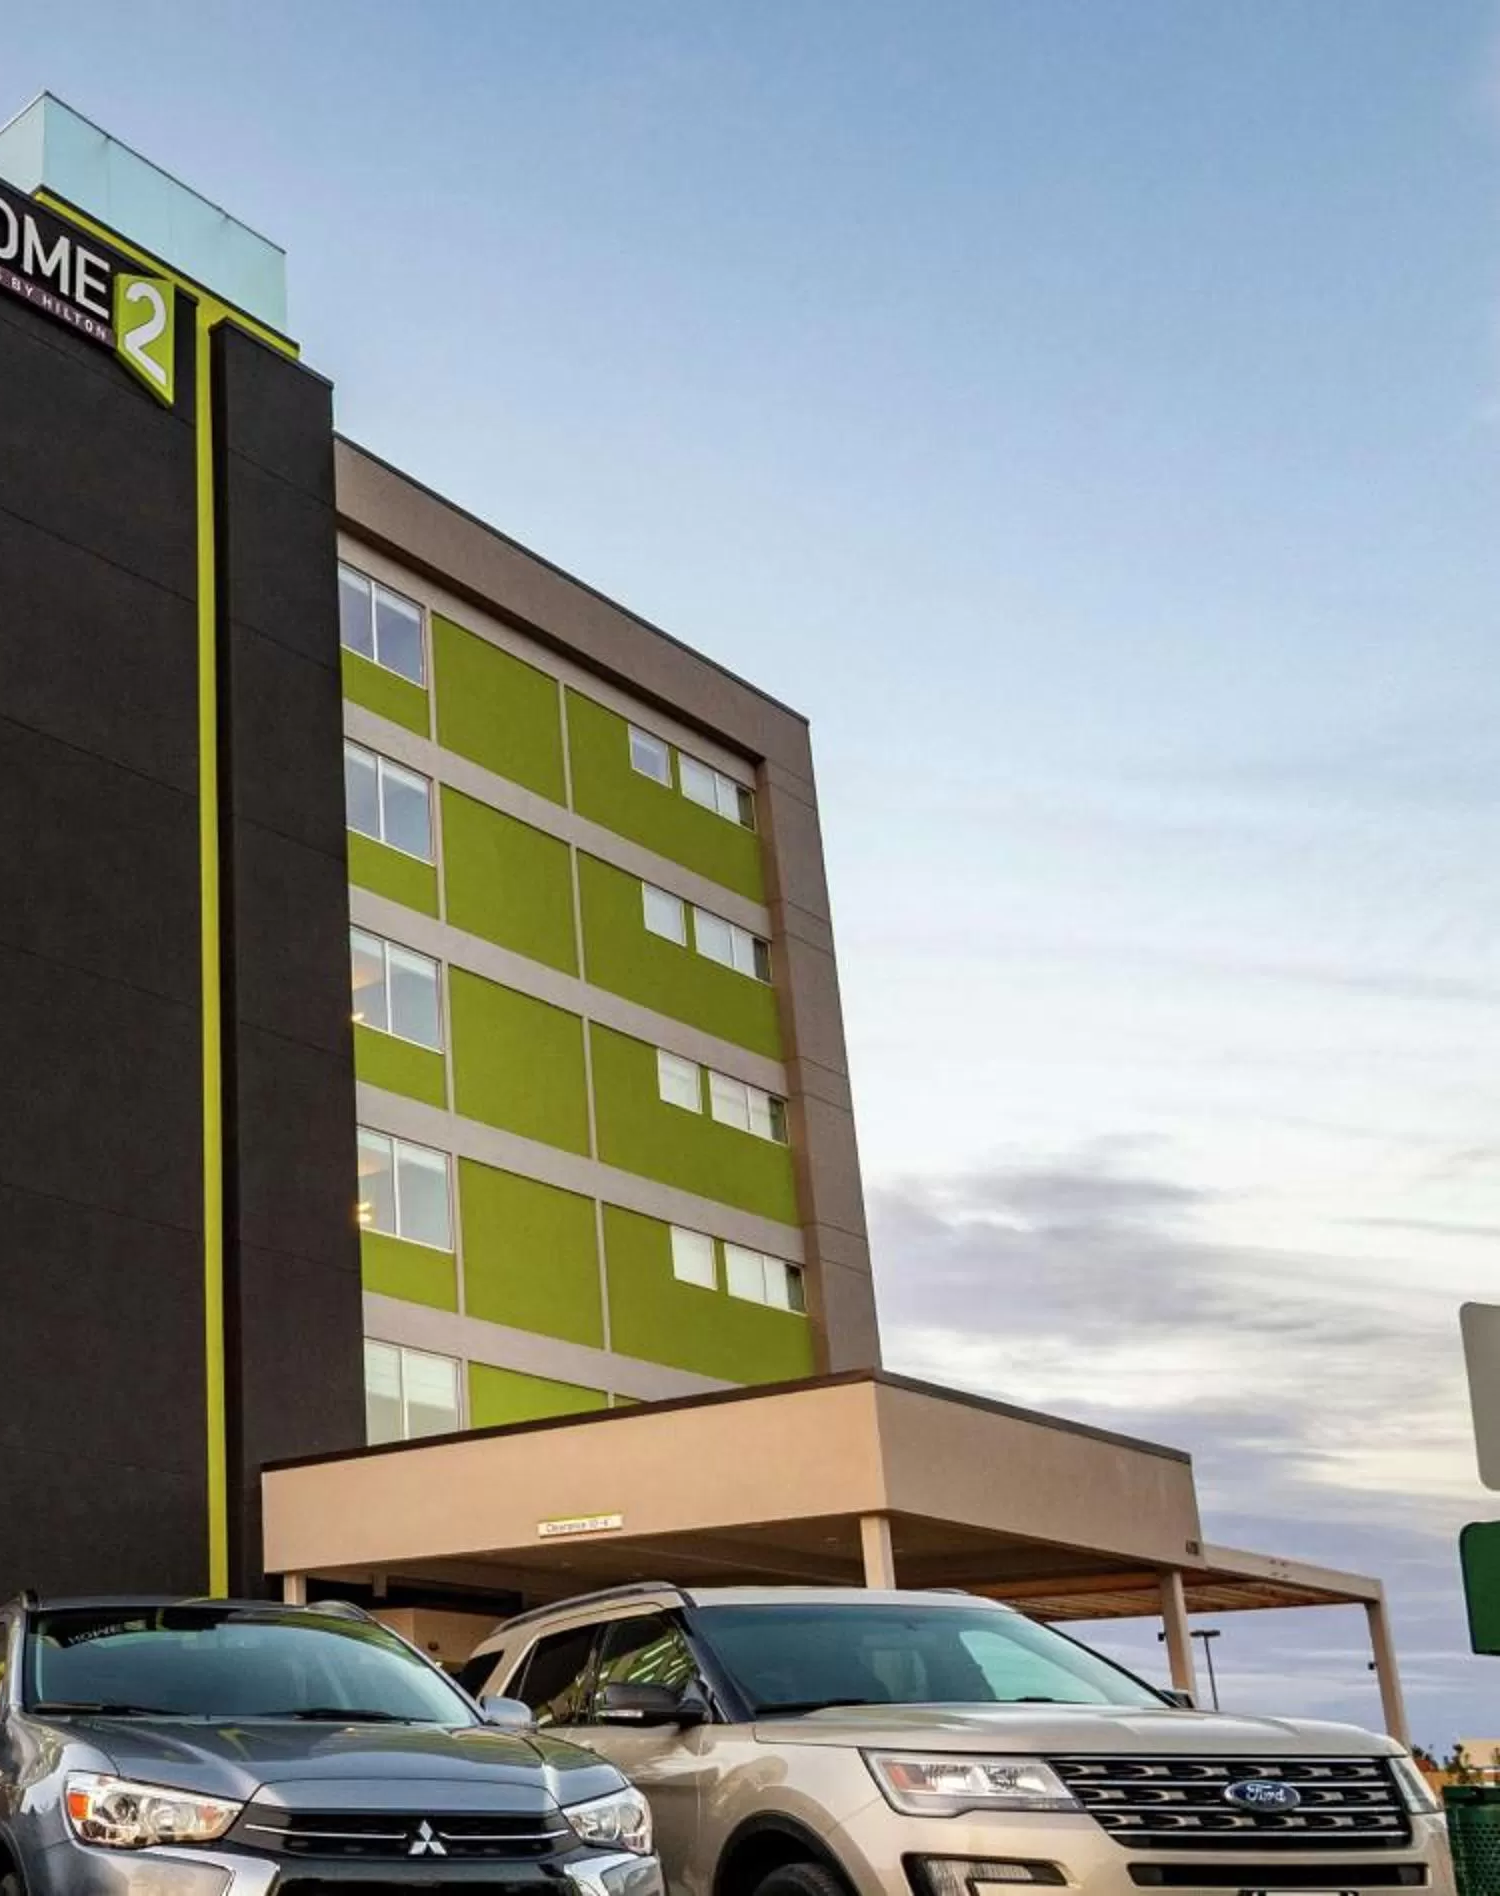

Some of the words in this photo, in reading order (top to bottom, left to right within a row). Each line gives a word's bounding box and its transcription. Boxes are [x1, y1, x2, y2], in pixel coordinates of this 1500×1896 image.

[11, 277, 33, 296] BY
[43, 294, 105, 340] HILTON
[125, 282, 166, 385] 2
[1246, 1783, 1285, 1802] Ford
